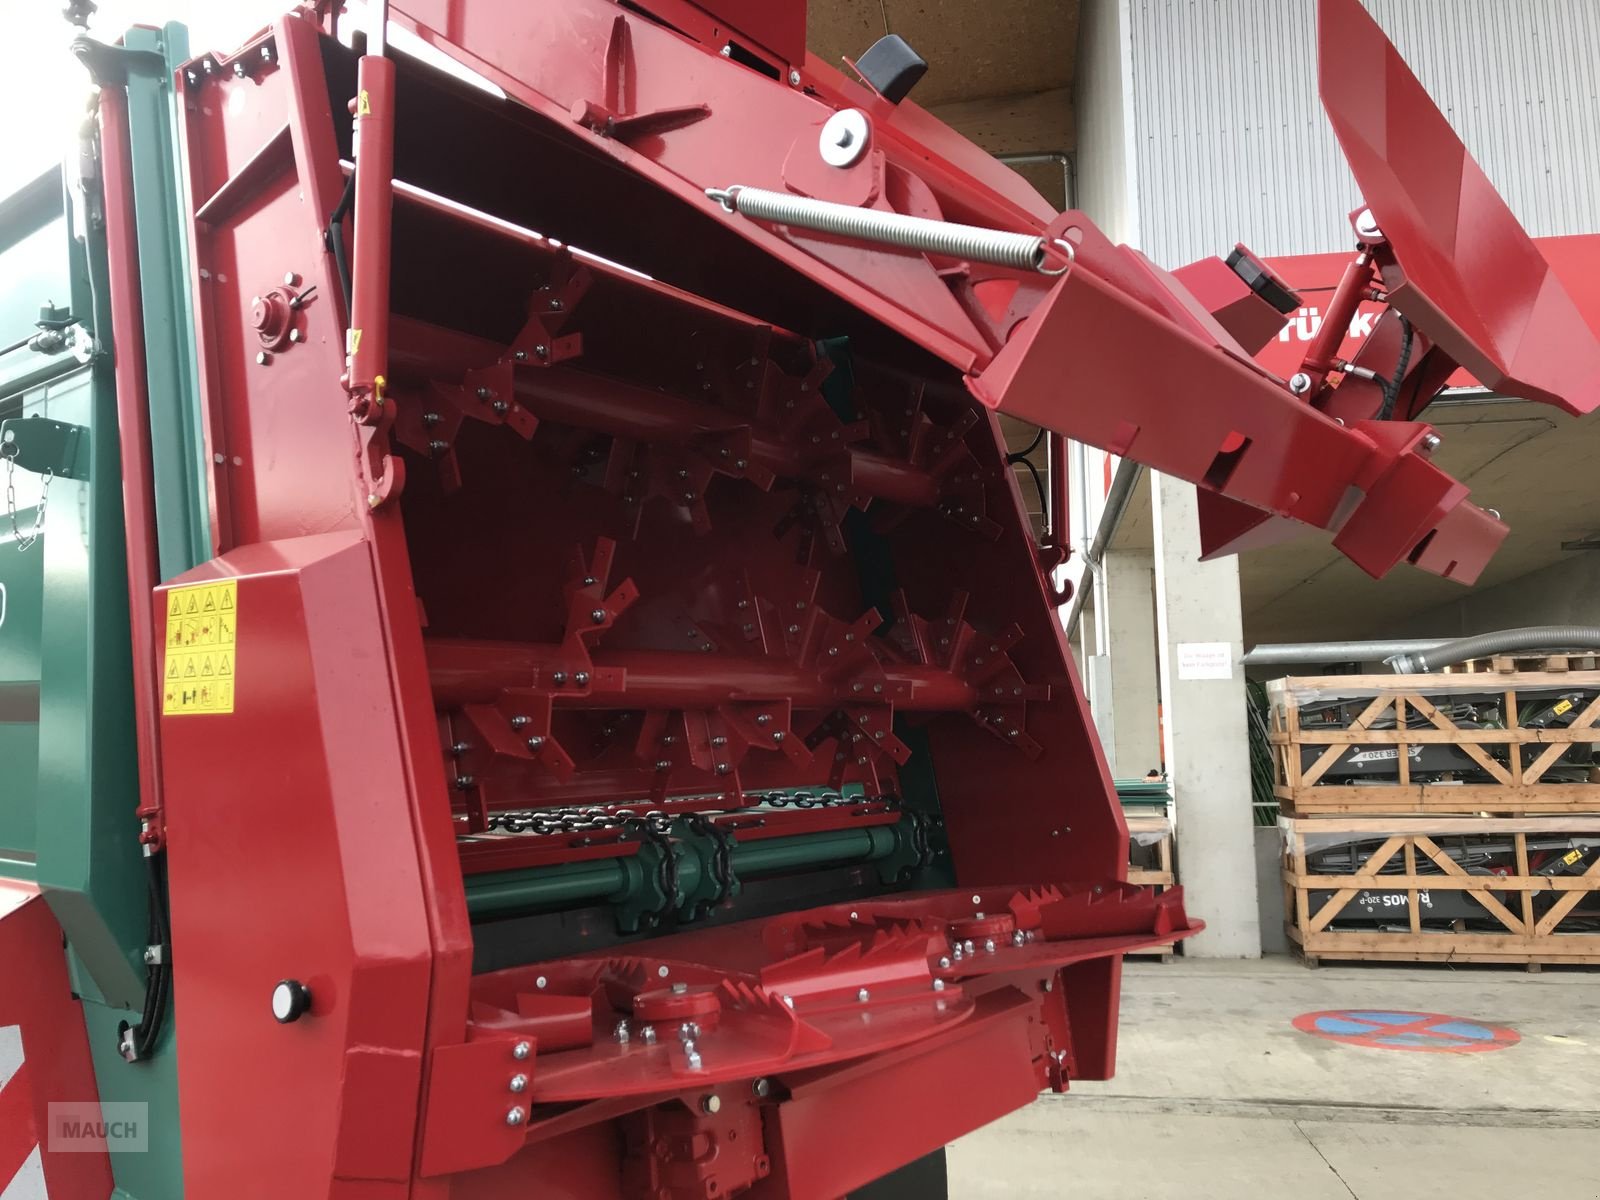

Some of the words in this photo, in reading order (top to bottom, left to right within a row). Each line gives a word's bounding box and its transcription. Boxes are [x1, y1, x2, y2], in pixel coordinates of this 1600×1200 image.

[1368, 751, 1384, 759] 320
[1359, 895, 1381, 905] 320-P
[1382, 893, 1430, 907] RMOS
